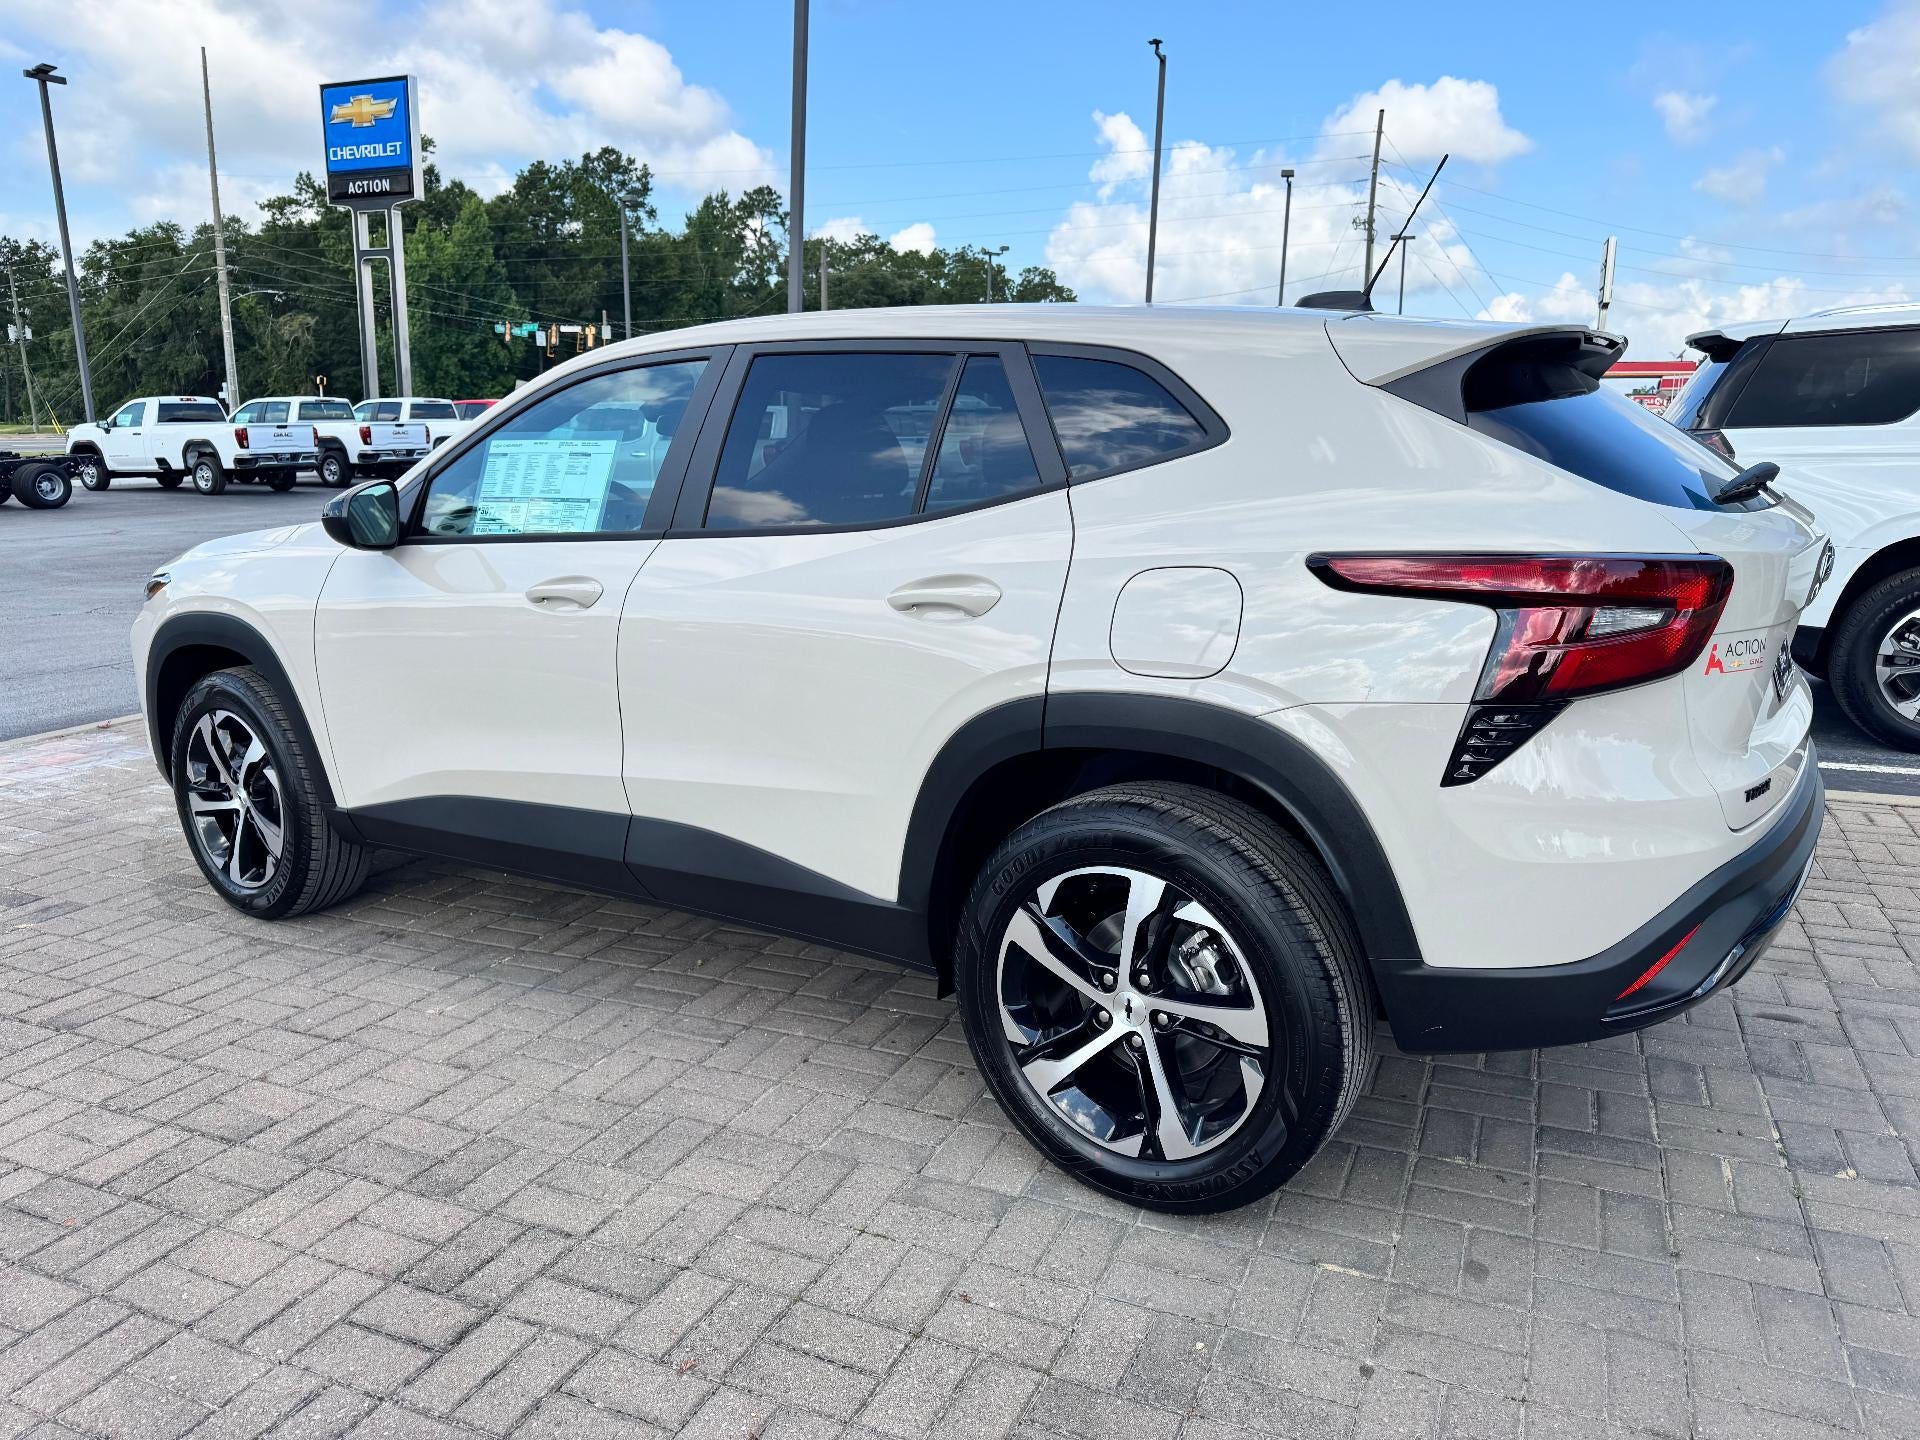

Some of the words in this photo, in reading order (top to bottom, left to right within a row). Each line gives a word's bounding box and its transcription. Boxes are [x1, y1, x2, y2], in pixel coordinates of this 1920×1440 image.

[329, 141, 402, 161] CHEVROLET
[348, 178, 390, 194] ACTION
[1725, 638, 1767, 657] ACTION
